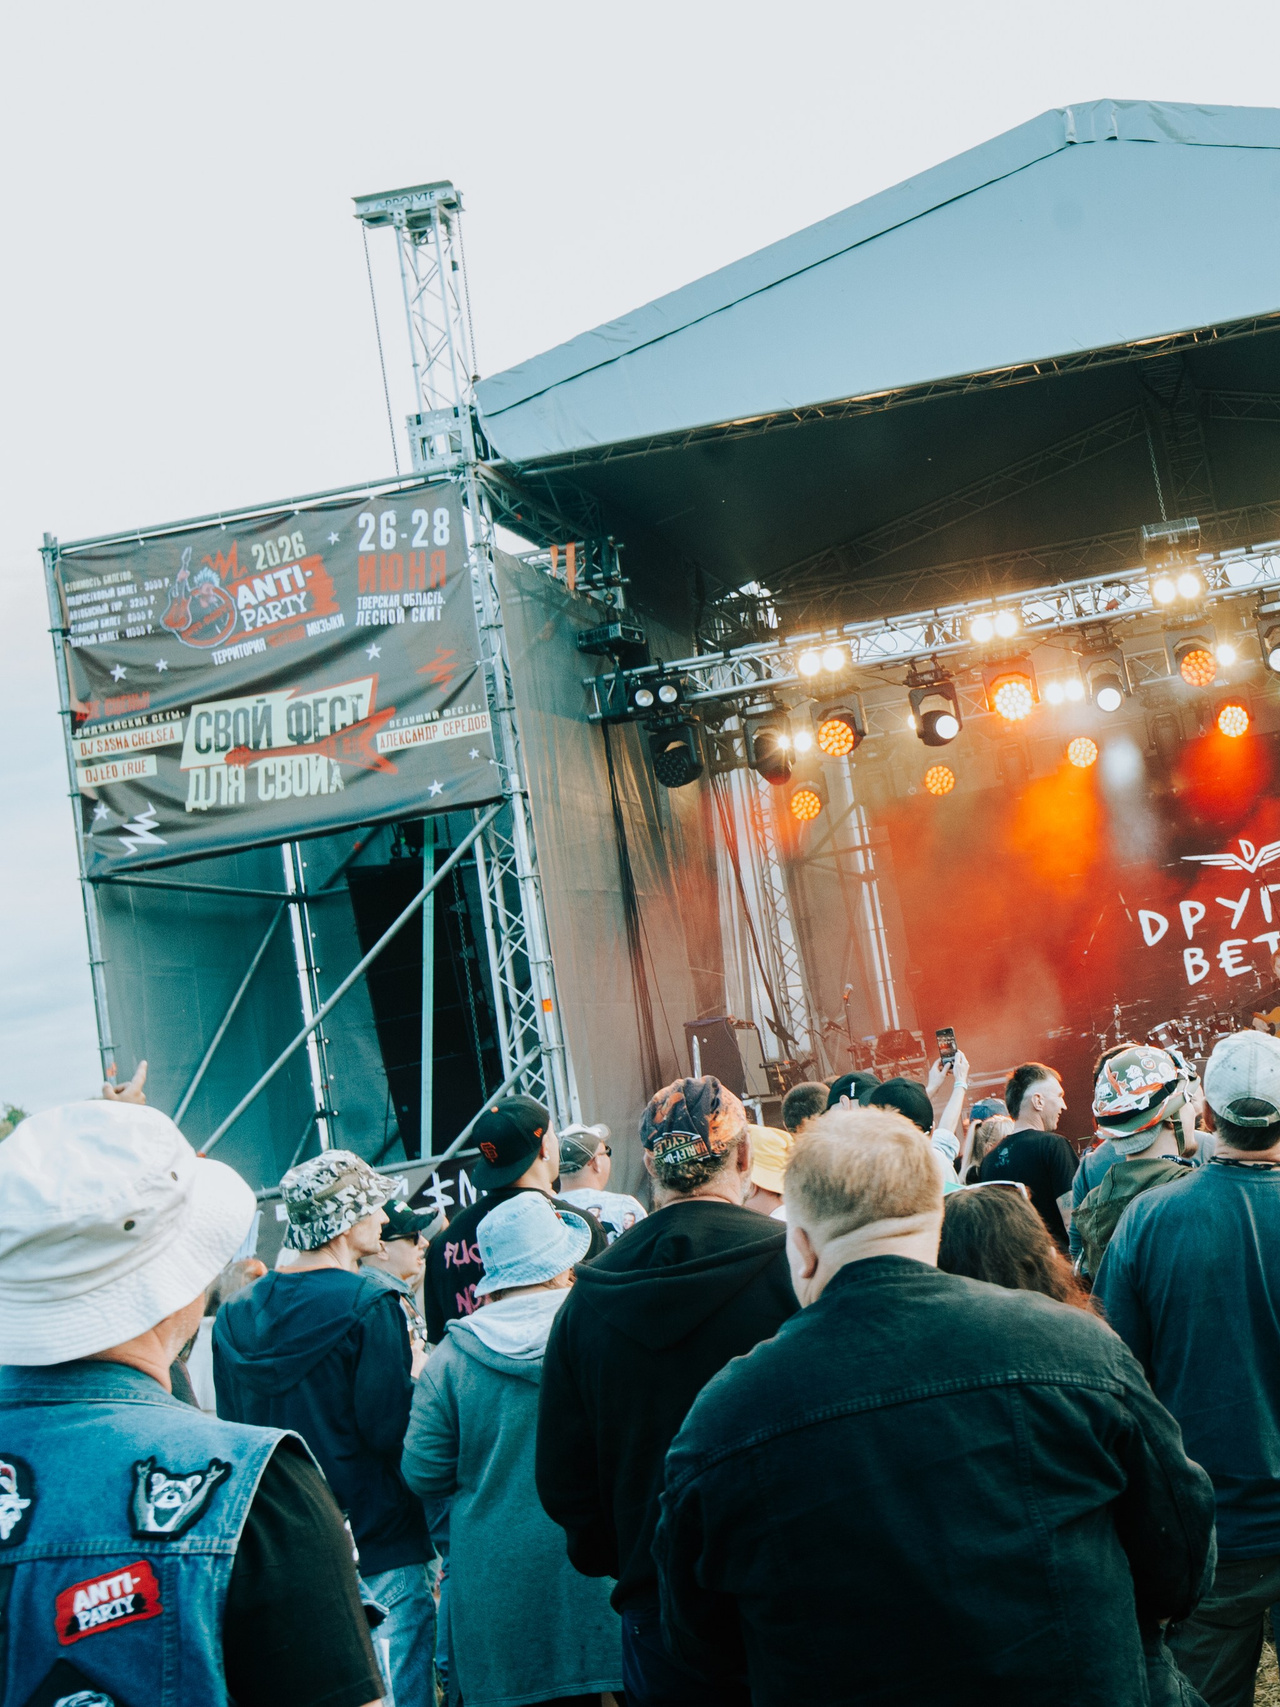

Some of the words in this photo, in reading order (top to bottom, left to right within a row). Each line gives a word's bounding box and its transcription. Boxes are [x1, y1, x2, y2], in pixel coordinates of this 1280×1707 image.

[358, 507, 450, 552] 26-28
[251, 530, 307, 571] 2026
[237, 564, 313, 610] ANTI-
[357, 549, 447, 594] ИЮНЯ
[240, 591, 307, 632] PARTY
[355, 606, 405, 626] ЛЕСНОЙ
[411, 606, 443, 623] СКИТ
[356, 594, 400, 610] ТВЕРСКАЯ
[211, 637, 267, 666] ТЕРРИТОРИЯ
[305, 613, 345, 637] МУЗЫКИ
[194, 698, 272, 754] СВОЙ
[286, 693, 363, 744] ФЕСТ
[380, 724, 438, 749] АЛЕКСАНДР
[389, 710, 440, 729] ВЕДУЩИЙ
[80, 742, 94, 757] DJ
[96, 736, 130, 753] SASHA
[131, 726, 175, 748] CHELSEA
[85, 768, 99, 783] DJ
[100, 764, 118, 780] LEO
[122, 760, 147, 776] TRUE
[185, 764, 245, 813] ДЛЯ
[73, 1571, 141, 1614] ANTI-
[75, 1594, 135, 1631] PARTY
